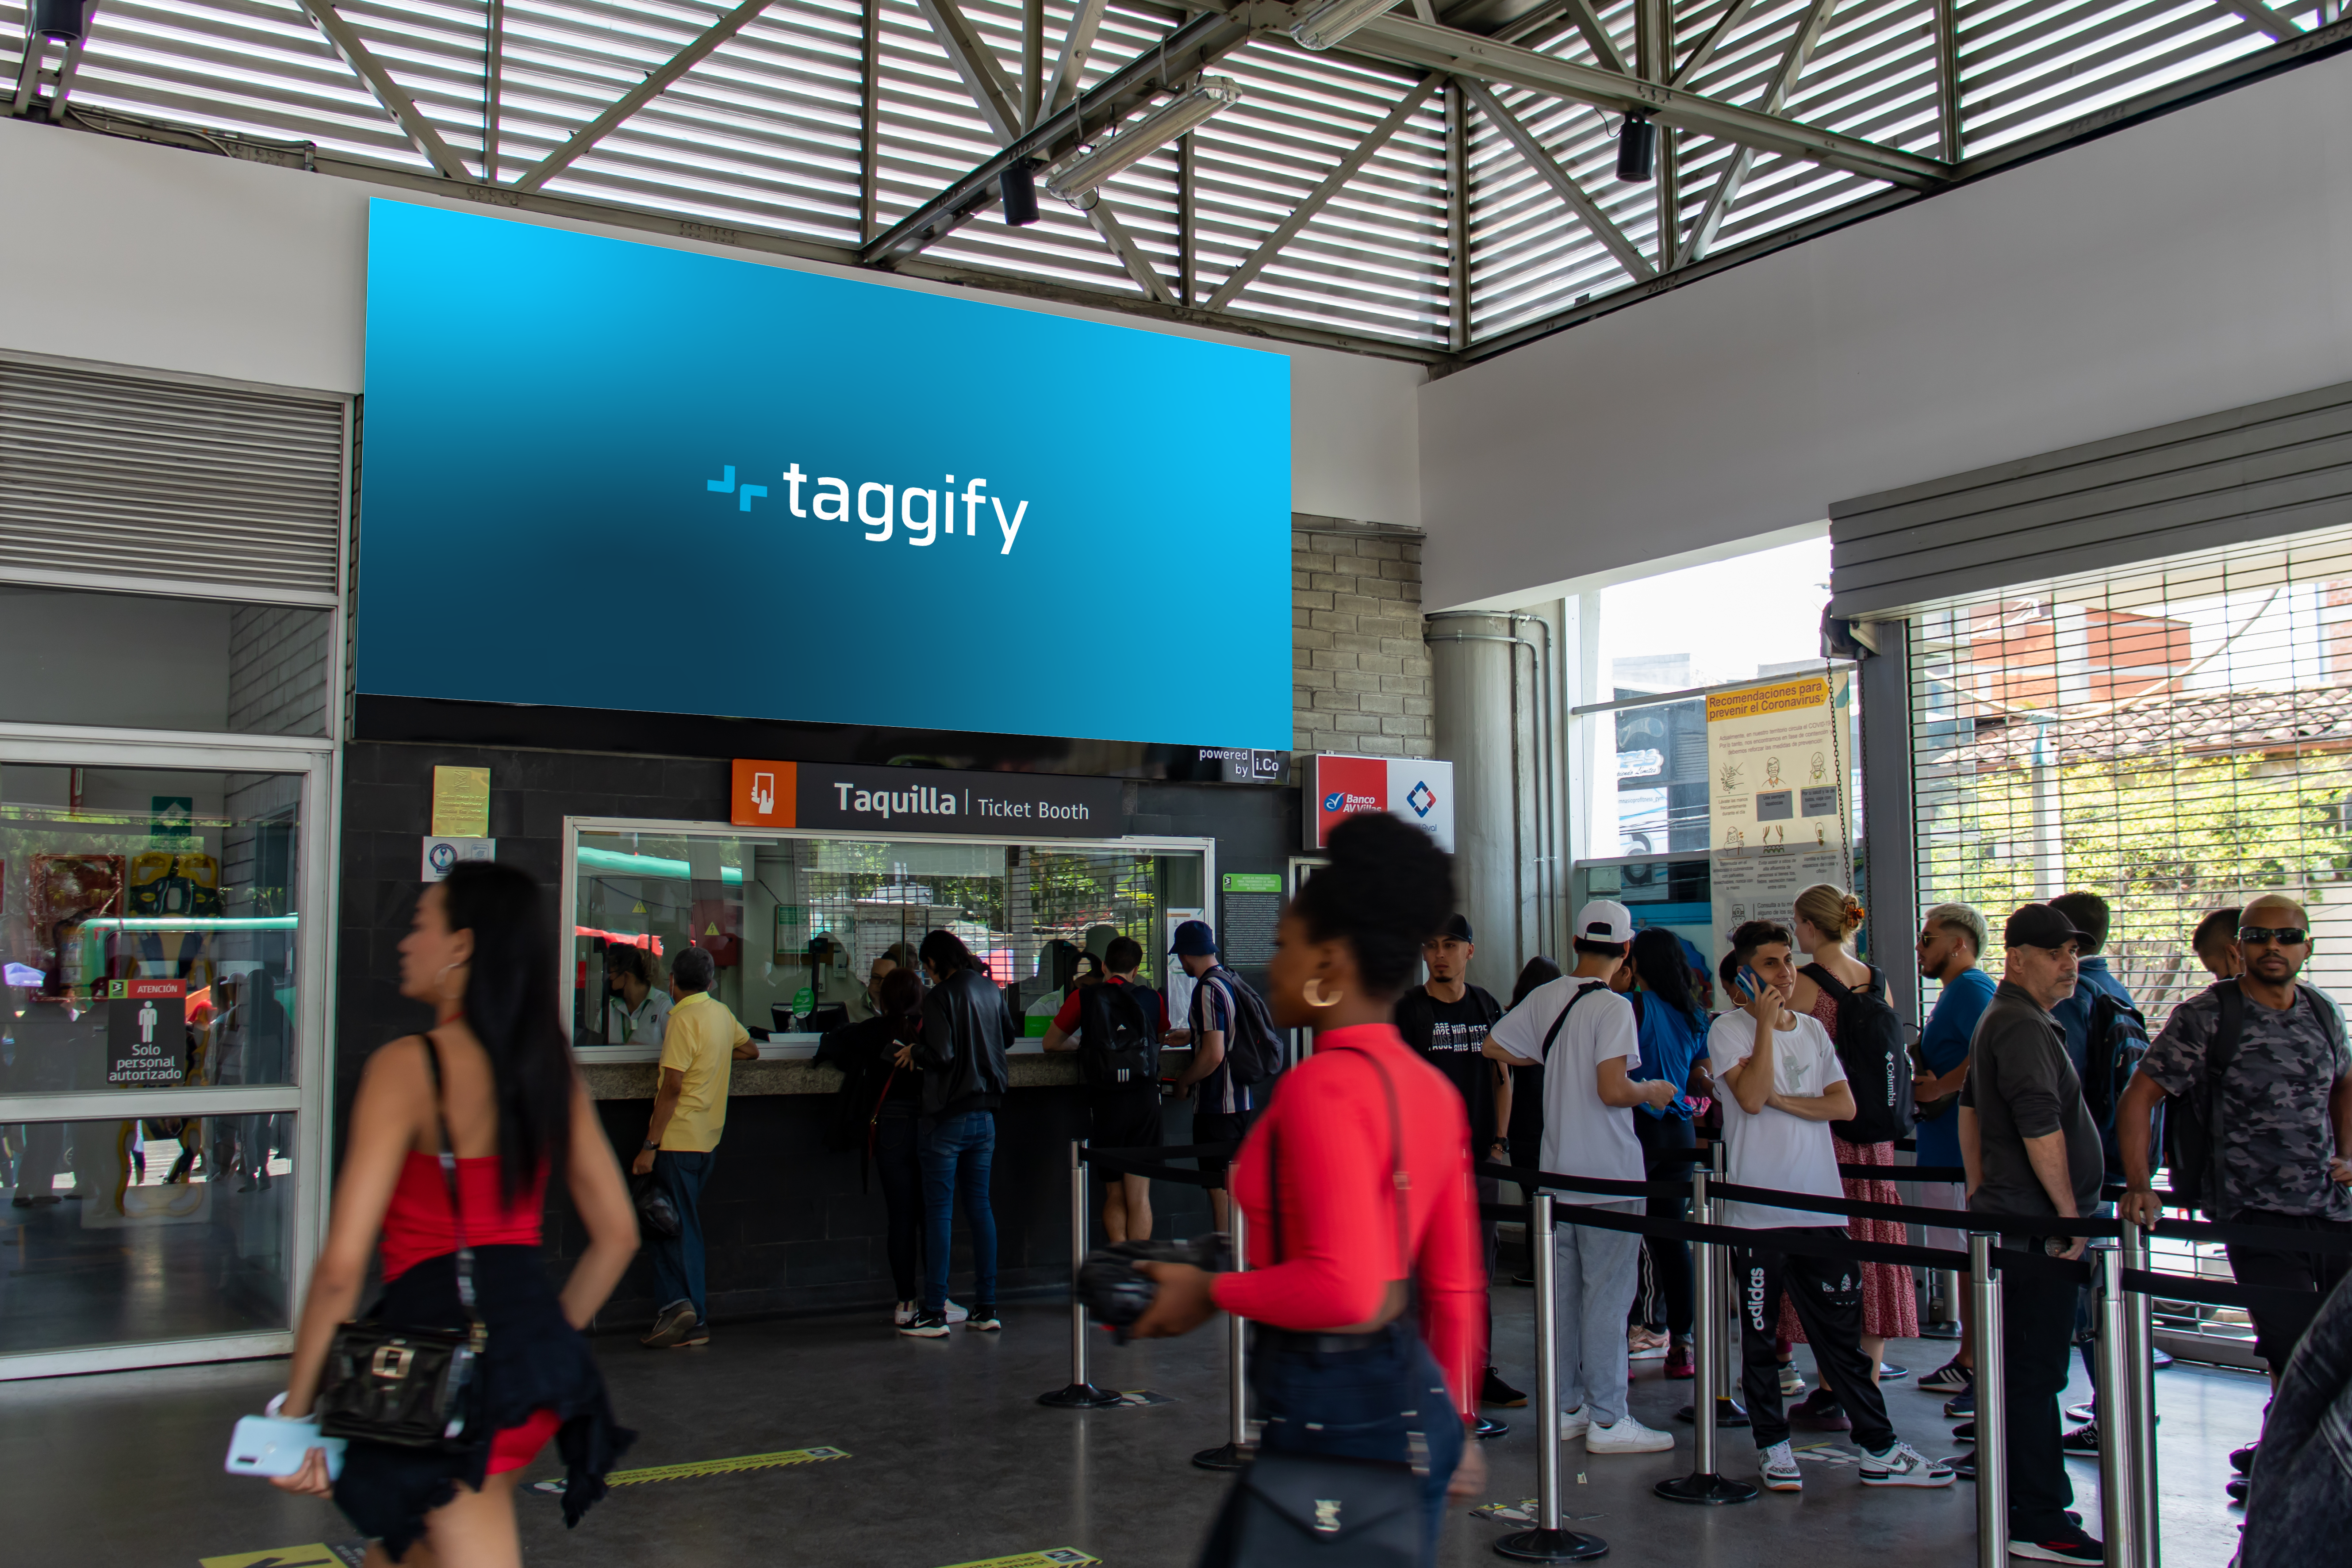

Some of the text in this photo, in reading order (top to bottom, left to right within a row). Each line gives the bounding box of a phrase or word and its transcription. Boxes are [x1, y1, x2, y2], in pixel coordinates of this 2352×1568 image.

[783, 462, 1029, 555] taggify
[1709, 683, 1822, 708] Recomendaciones para
[1709, 694, 1824, 721] prevenir el Coronavirus:
[1805, 729, 1828, 737] contención
[1199, 749, 1248, 761] powered
[1235, 763, 1248, 778] by
[834, 782, 1089, 820] Taquilla Ticket Booth
[1346, 794, 1375, 805] Banco
[1343, 804, 1357, 813] AV
[137, 984, 178, 993] ATENCIÓN
[132, 1044, 161, 1056] Solo
[116, 1055, 176, 1071] personal
[109, 1068, 182, 1081] autorizado
[1886, 1062, 1896, 1107] Columbia
[1747, 1267, 1765, 1331] adidas
